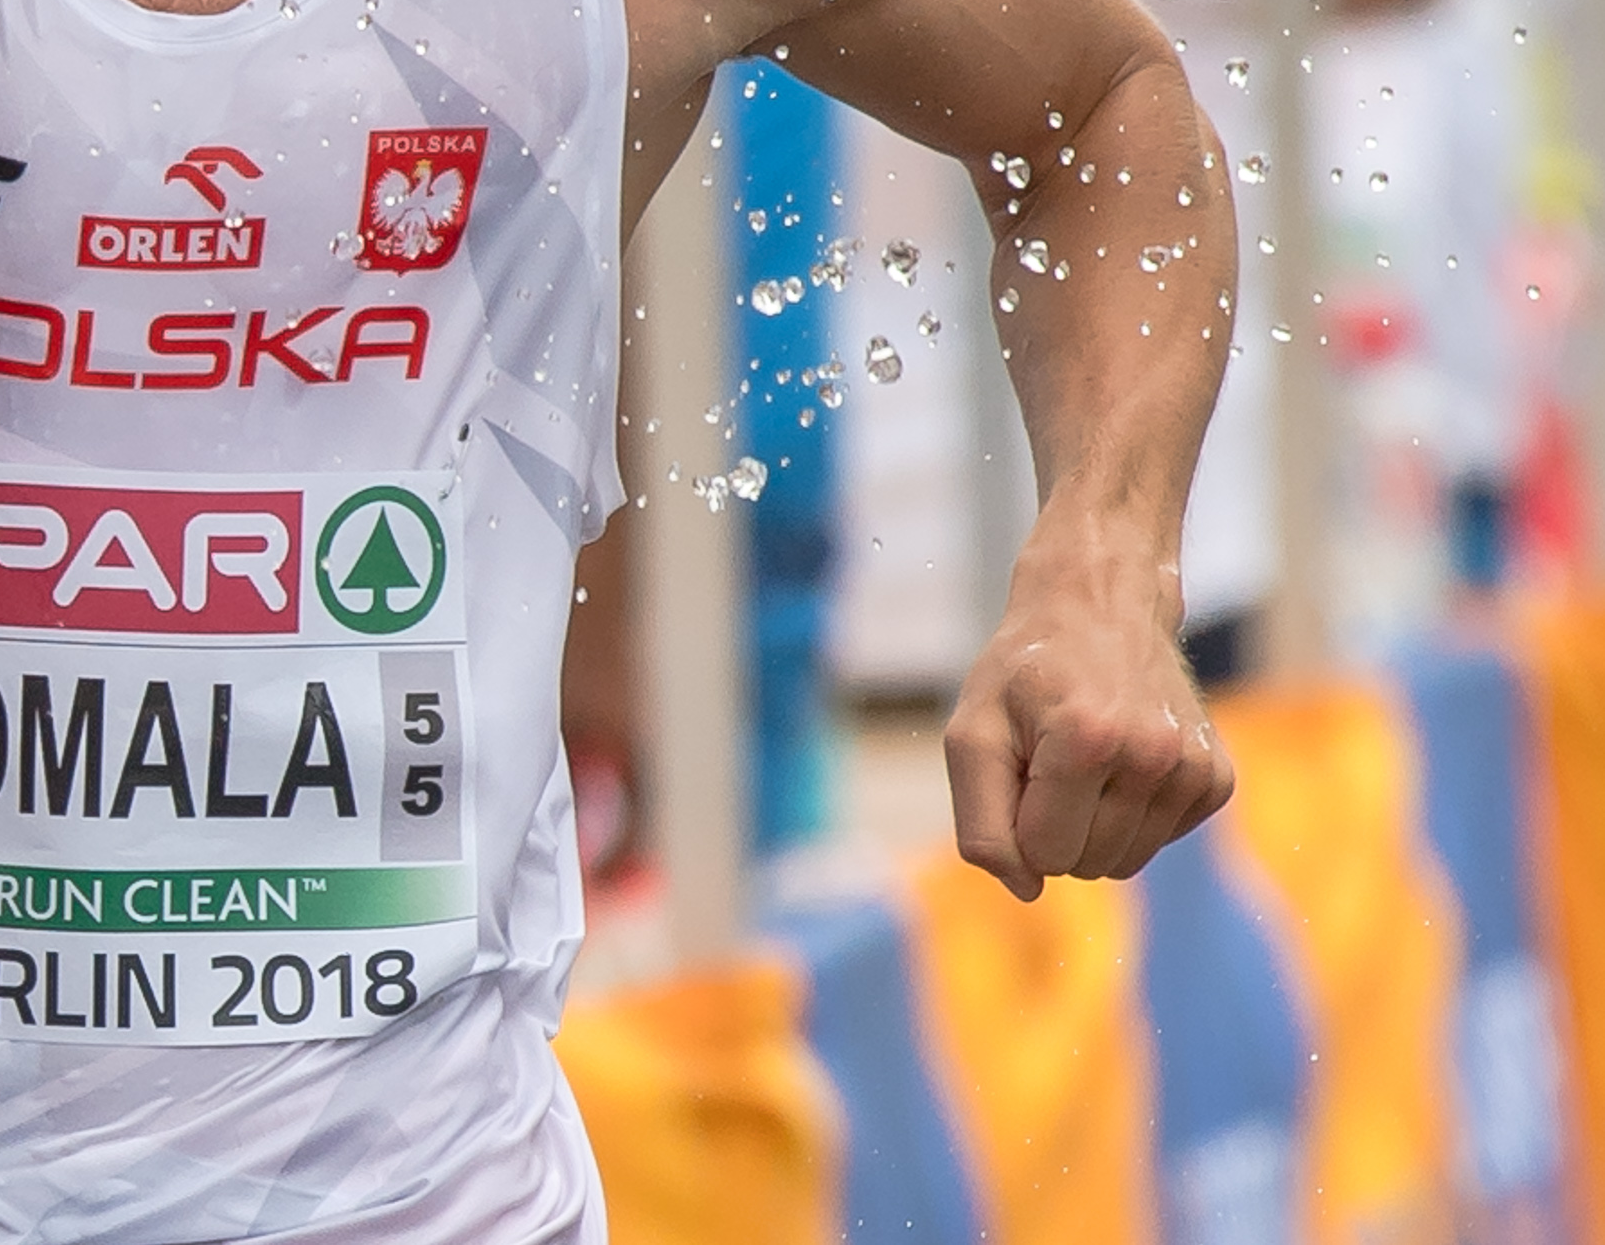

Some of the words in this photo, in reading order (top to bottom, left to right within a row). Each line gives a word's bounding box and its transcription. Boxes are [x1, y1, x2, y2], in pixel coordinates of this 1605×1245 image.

[376, 134, 479, 155] POLSKA
[88, 222, 253, 264] ORLEN
[403, 692, 445, 746] 5
[400, 765, 445, 818] 5
[210, 948, 419, 1029] 2018
